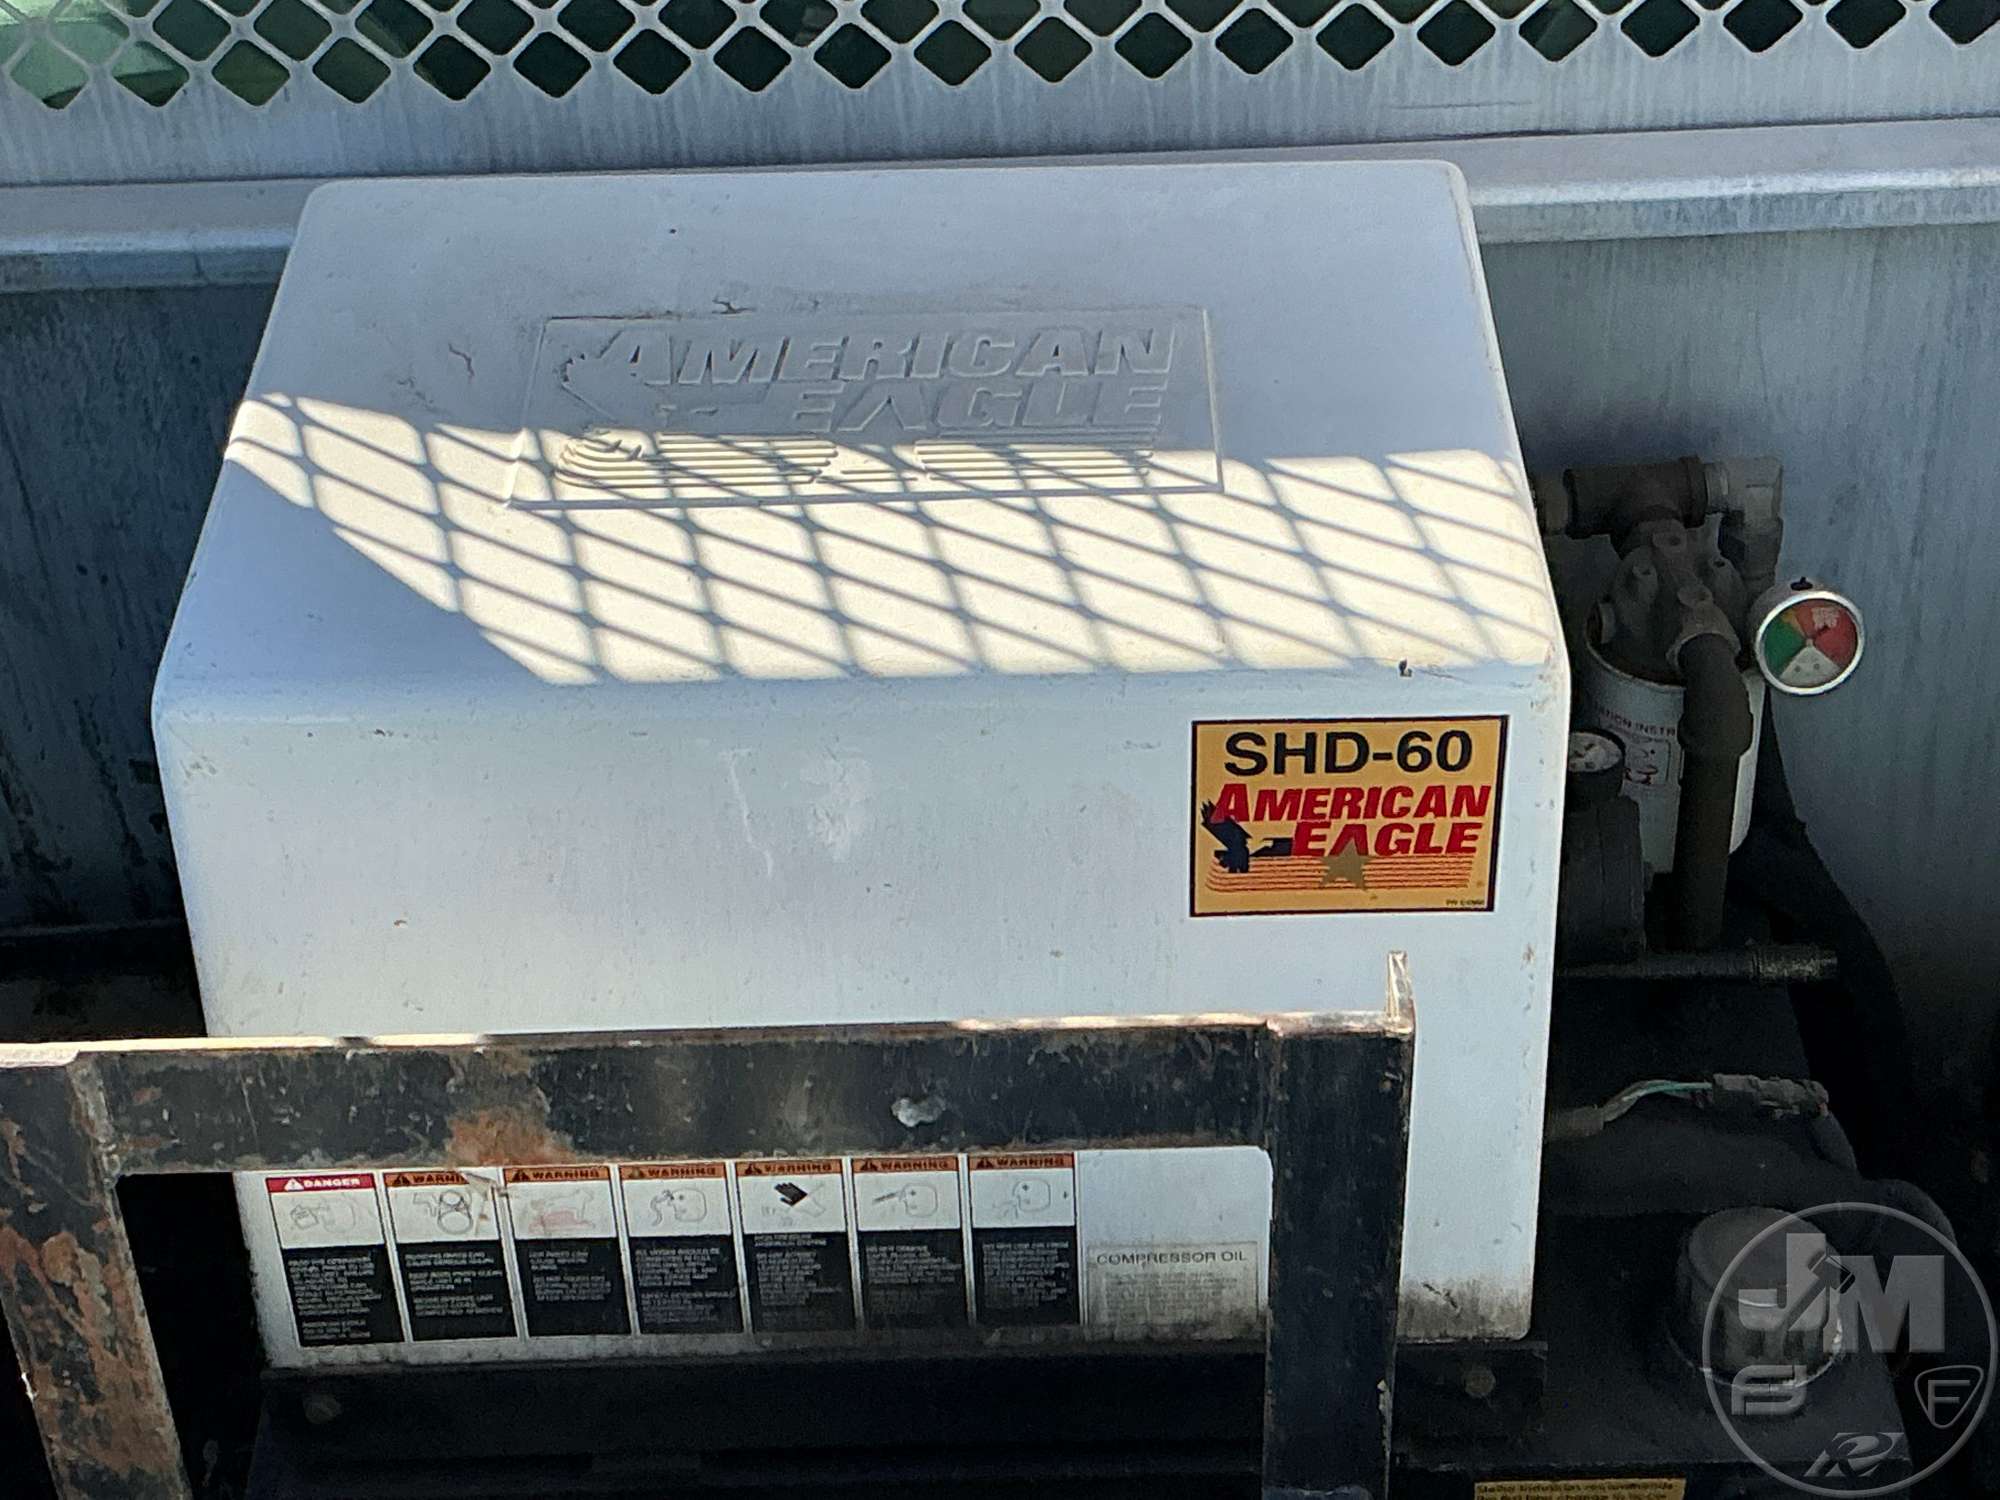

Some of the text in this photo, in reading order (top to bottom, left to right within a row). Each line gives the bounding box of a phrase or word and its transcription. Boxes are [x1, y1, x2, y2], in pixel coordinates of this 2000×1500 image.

[598, 327, 1176, 386] AMERICAN
[765, 377, 1168, 432] EAGLE
[1224, 730, 1473, 776] SHD-60
[1210, 783, 1491, 824] AMERICAN
[1291, 821, 1482, 857] EAGLE
[765, 1163, 832, 1173] WARNING
[881, 1160, 949, 1170] WARNING
[997, 1157, 1065, 1167] WARNING
[532, 1169, 599, 1181] WARNING
[648, 1167, 716, 1177] WARNING
[304, 1177, 360, 1188] DANGER
[413, 1173, 465, 1184] WARNI
[1097, 1250, 1248, 1265] COMPRESSOR OIL
